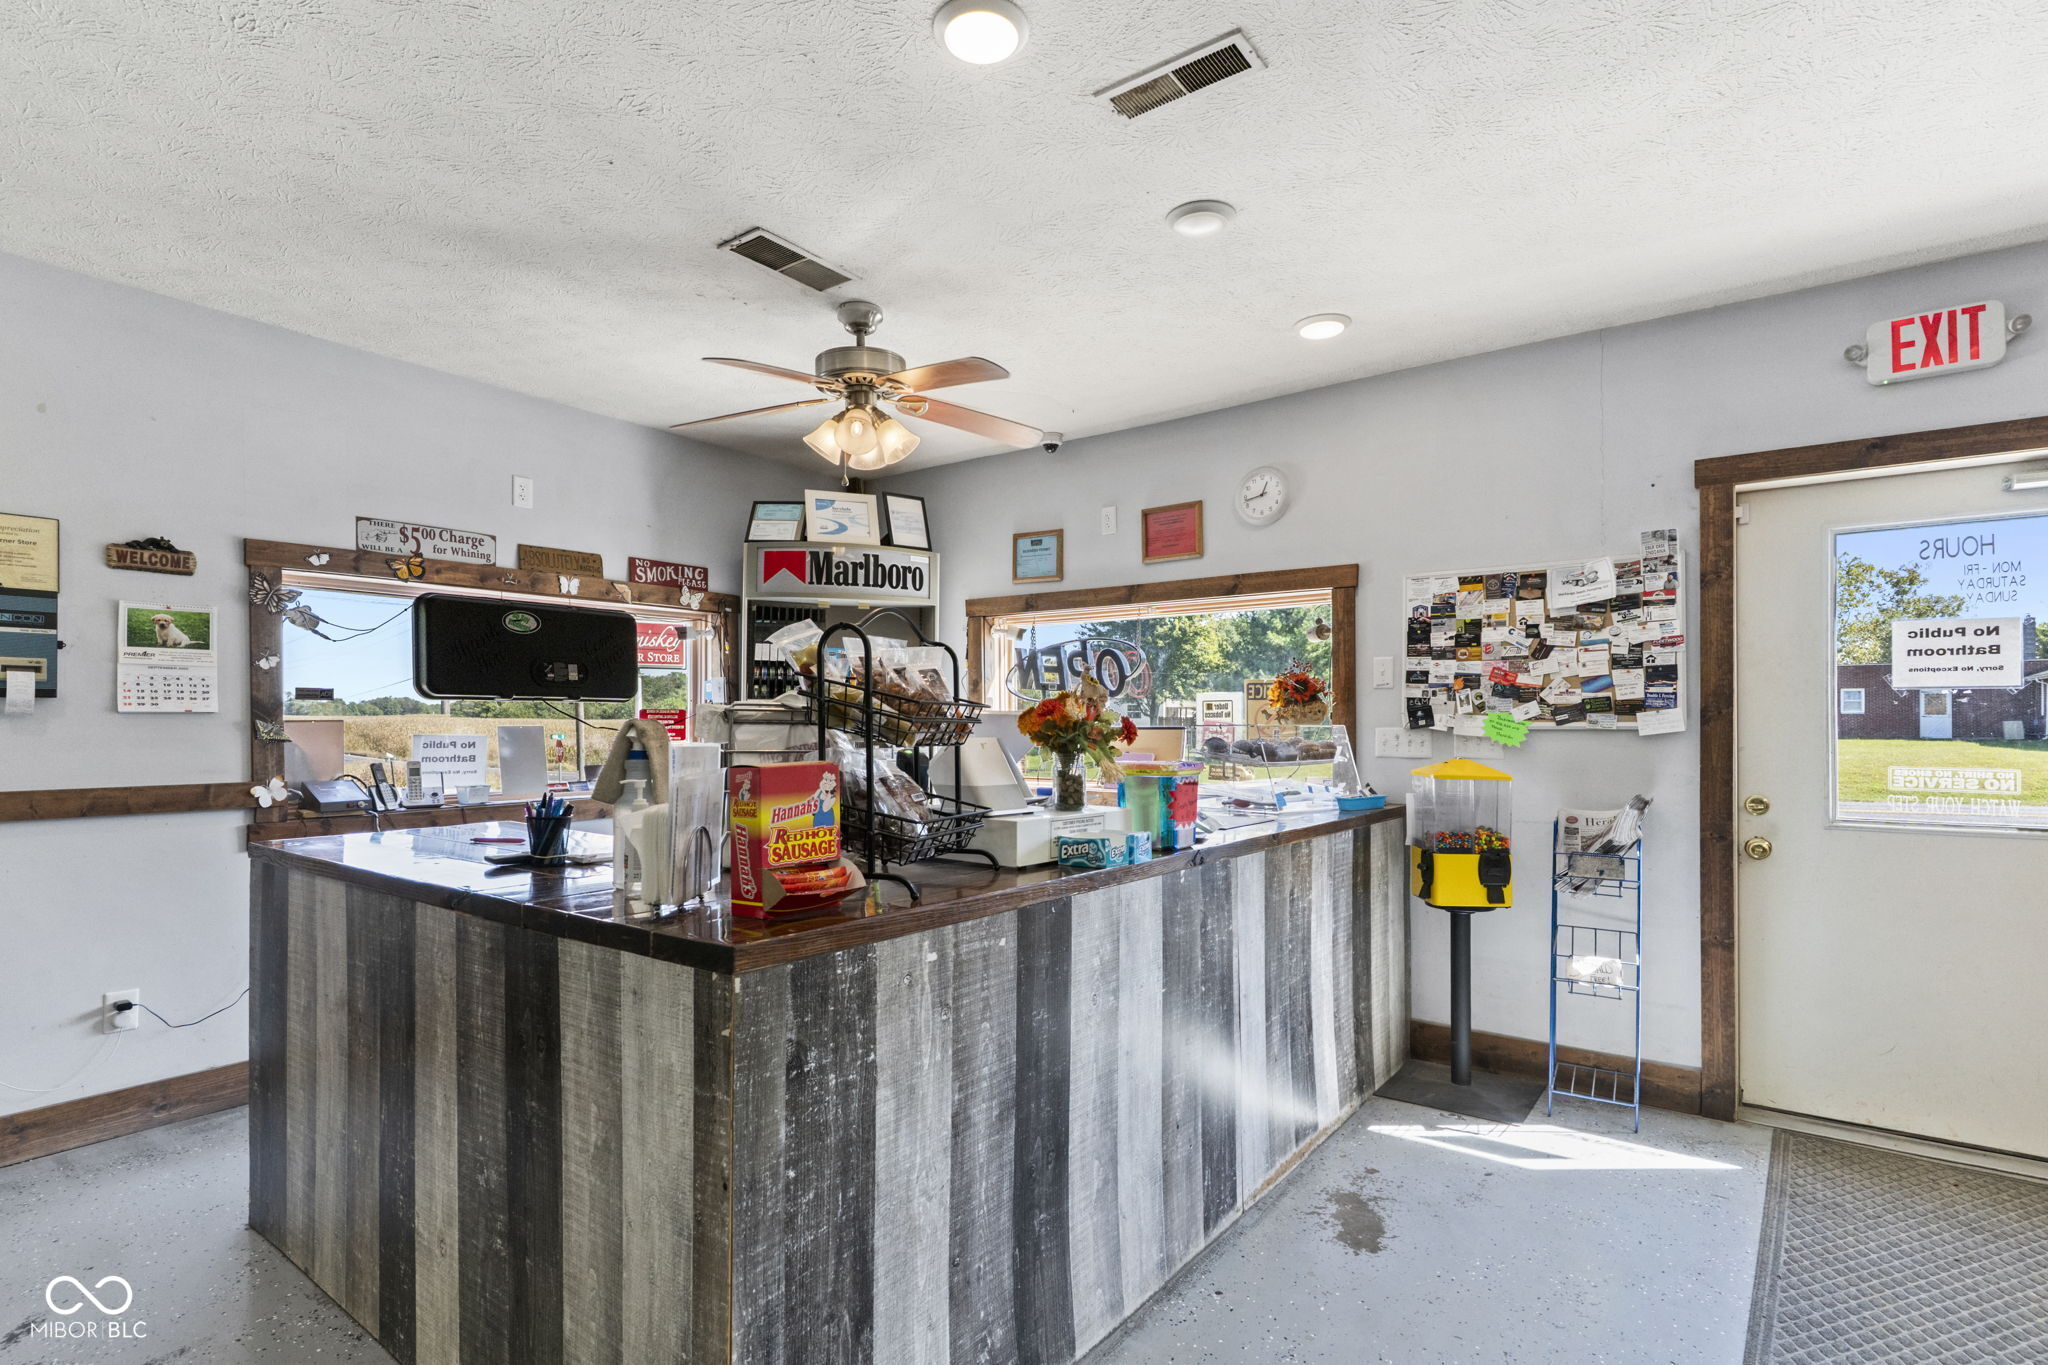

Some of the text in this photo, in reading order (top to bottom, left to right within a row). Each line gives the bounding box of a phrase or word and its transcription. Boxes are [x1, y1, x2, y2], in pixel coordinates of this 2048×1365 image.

[1891, 304, 1986, 373] EXIT
[369, 520, 396, 529] THERE
[362, 543, 381, 551] WILL
[439, 529, 485, 550] Charge
[116, 549, 190, 569] WELCOME
[433, 545, 491, 563] for Whining
[523, 551, 579, 570] ABSOLUTELY
[635, 559, 650, 567] NO
[635, 566, 704, 583] SMOKING
[808, 551, 924, 592] Marlboro
[678, 578, 707, 588] PLEASE
[638, 626, 680, 652] iskey
[771, 797, 819, 824] Hannah's
[772, 840, 836, 863] SAUSAGE
[1061, 843, 1089, 859] Extra
[735, 824, 757, 899] Hannah's
